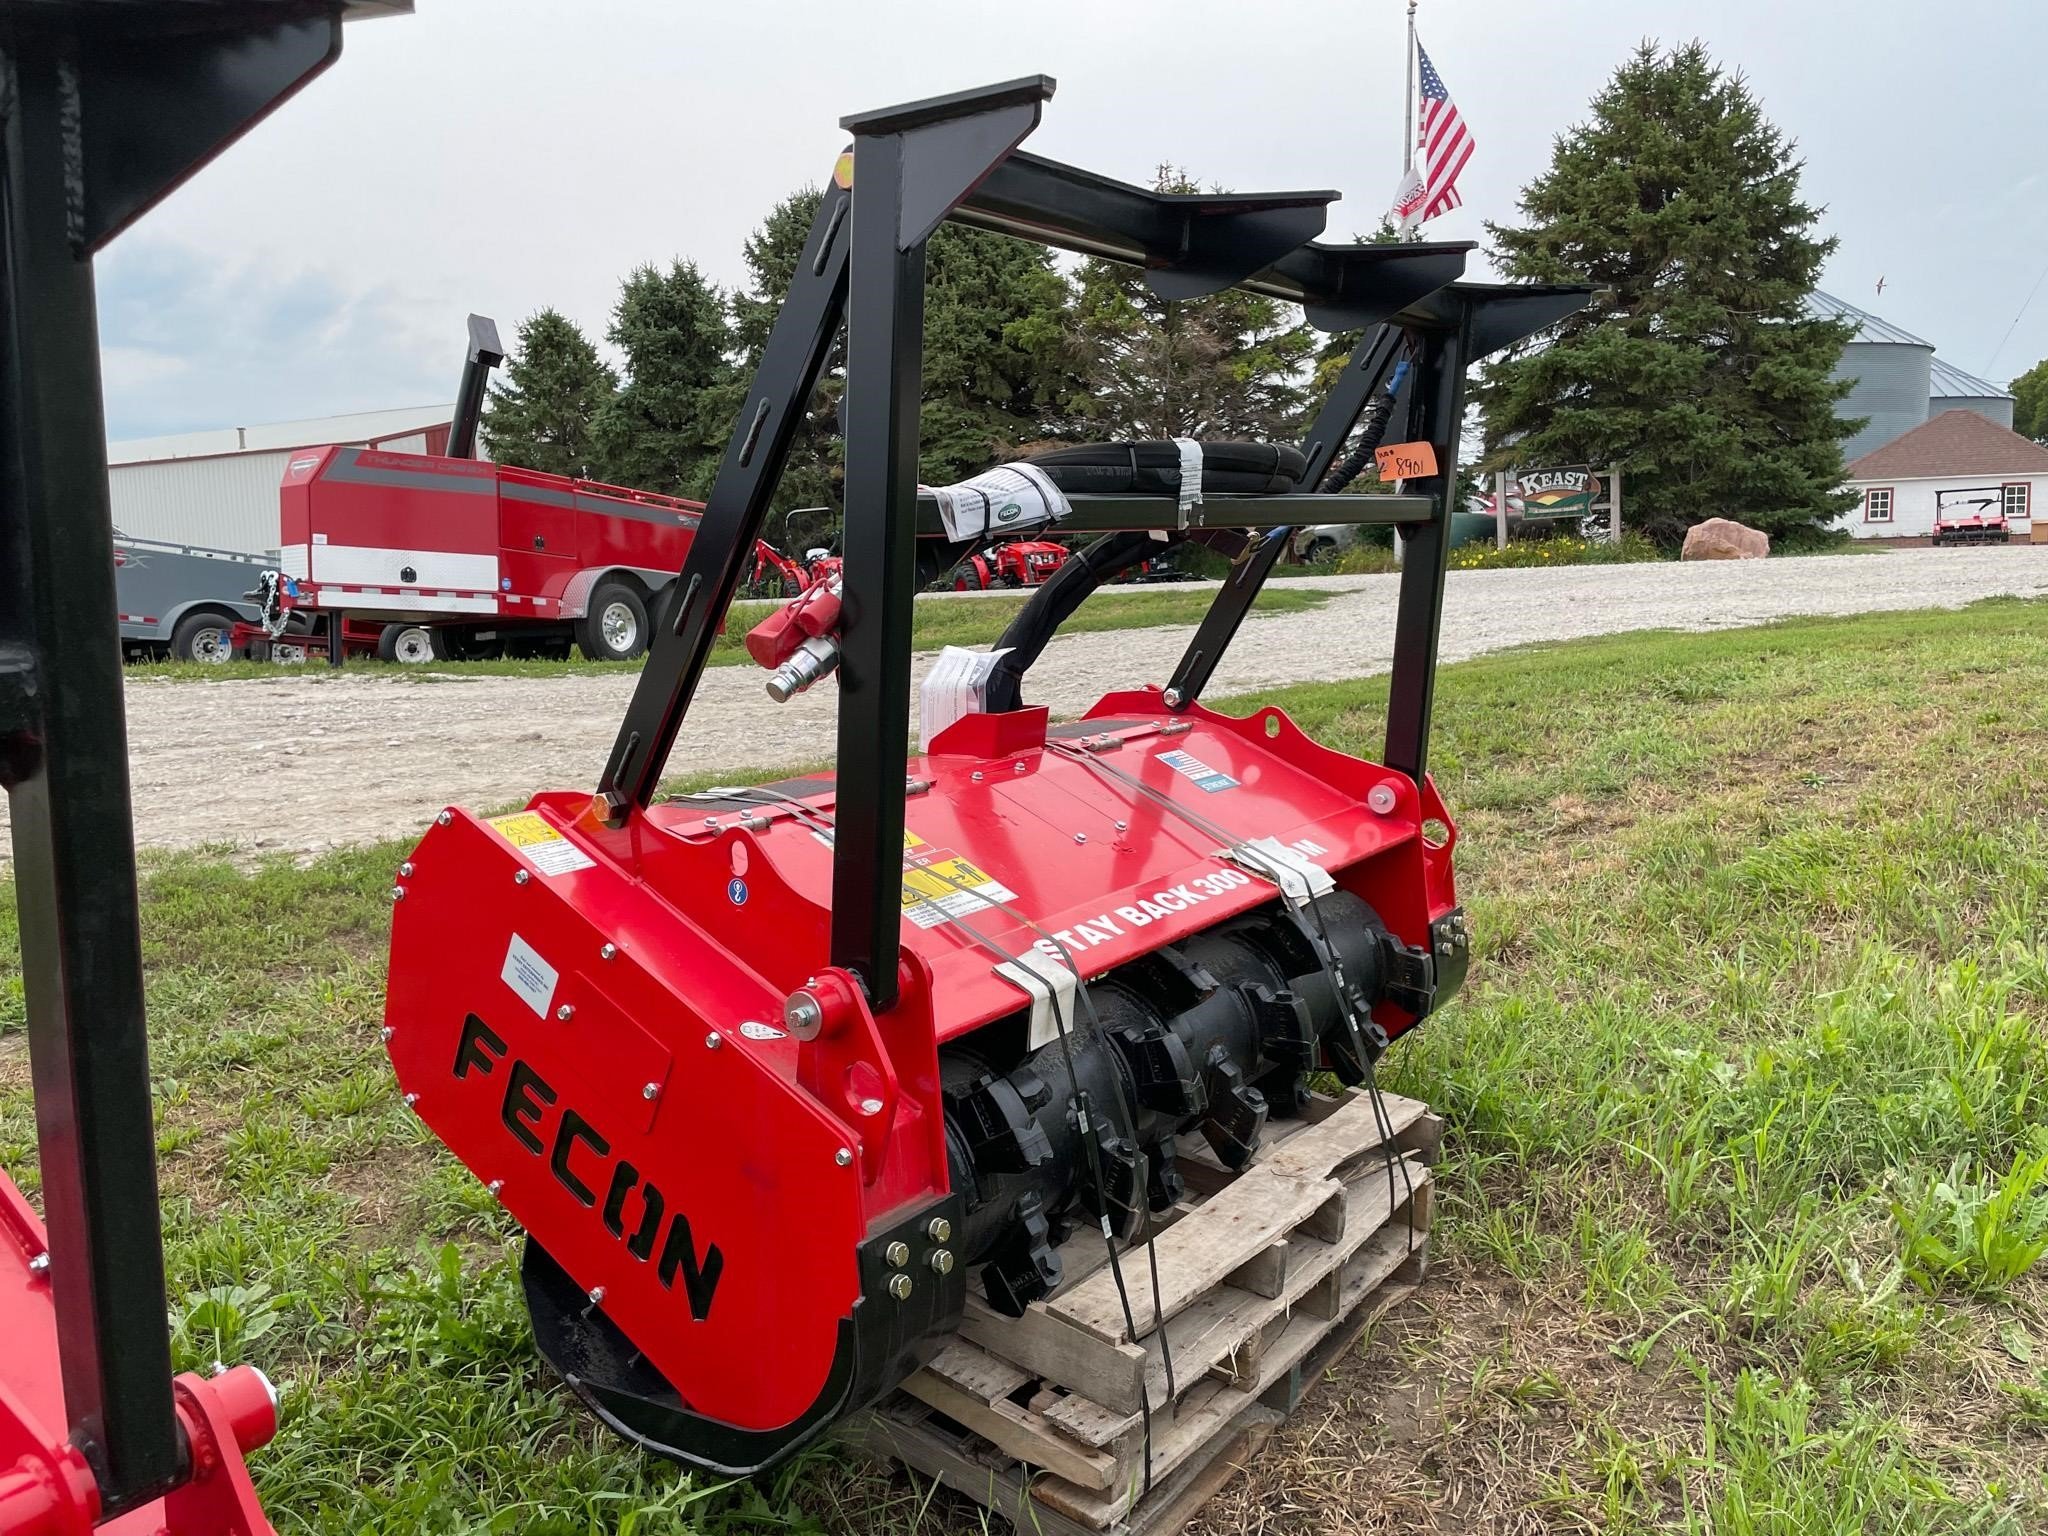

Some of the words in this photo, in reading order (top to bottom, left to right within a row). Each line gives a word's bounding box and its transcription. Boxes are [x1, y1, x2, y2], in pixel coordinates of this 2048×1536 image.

[1396, 457, 1424, 476] 8901
[1518, 472, 1589, 496] KEAST
[1032, 914, 1125, 960] STAY
[1114, 884, 1209, 928] BACK
[1192, 868, 1250, 896] 300
[453, 1012, 724, 1322] FECON
